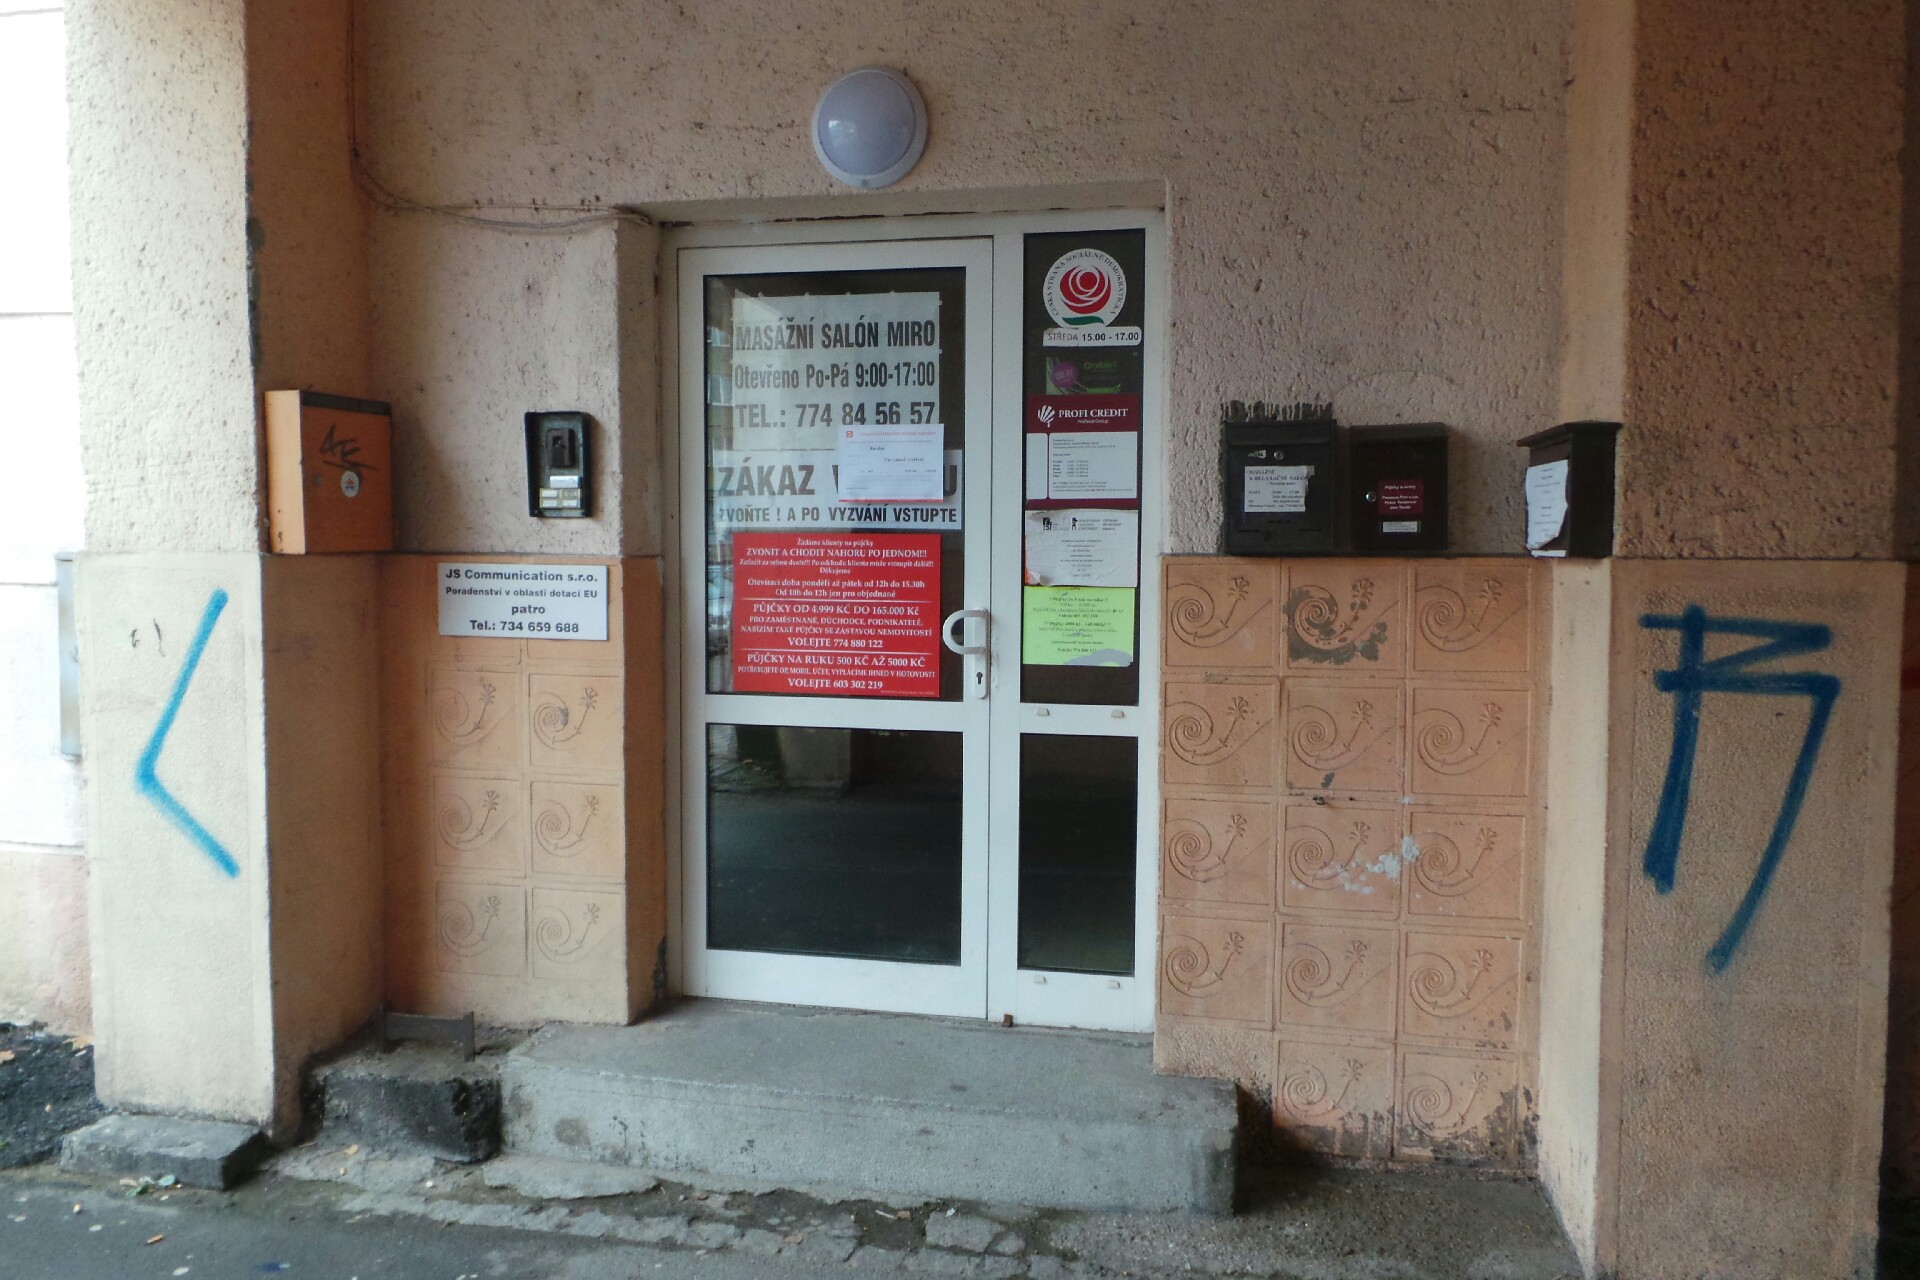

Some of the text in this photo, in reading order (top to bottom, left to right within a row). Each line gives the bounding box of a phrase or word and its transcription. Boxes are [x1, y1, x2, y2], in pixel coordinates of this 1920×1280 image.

[1047, 261, 1065, 291] STRANA
[736, 315, 936, 351] MASÁŽNÍ SALÓN MIRO
[1048, 332, 1078, 341] STŘEDA
[1082, 333, 1106, 342] 15.00
[1115, 332, 1139, 341] 17.00
[734, 361, 935, 389] Otevřeno Po-Pá 9:00-17:00
[735, 401, 935, 428] TEL.: 774 84 56 57
[1059, 408, 1129, 418] PROFI CREDIT
[718, 457, 815, 496] ZÁKAZ
[719, 504, 957, 522] ZVOŇTE ! A PO VYZVÁNÍ VSTUPTE
[746, 548, 780, 556] ZVONIT
[782, 548, 788, 556] A
[789, 548, 825, 557] CHODIT
[827, 549, 866, 557] NAHORU
[868, 549, 880, 557] PO
[446, 569, 598, 582] JS Communication s.r.o.
[747, 578, 780, 586] Otevírací
[802, 579, 830, 588] pondělí
[841, 580, 862, 589] pátek
[864, 580, 874, 588] od
[876, 580, 889, 588] 12h
[890, 580, 900, 588] do
[902, 580, 925, 588] 15.30h
[446, 586, 502, 596] Poradenství
[513, 589, 547, 597] oblasti
[550, 589, 581, 598] dotací
[584, 590, 598, 598] EU
[815, 589, 827, 597] 12h
[828, 590, 841, 599] jen
[857, 590, 896, 599] objednané
[511, 605, 546, 616] patro
[753, 602, 919, 615] PŮJČKY OD 4.999 KČ DO 165.000 Kč
[469, 620, 579, 633] Tel.: 734 659 688
[795, 626, 823, 635] PŮJČKY
[788, 637, 831, 648] VOLEJTE
[833, 639, 849, 647] 774
[850, 639, 866, 647] 880
[747, 652, 925, 667] PŮJČKY NA RUKU 500 KČ AŽ 5000 KČ
[788, 678, 883, 689] VOLEJTE 603 302 219
